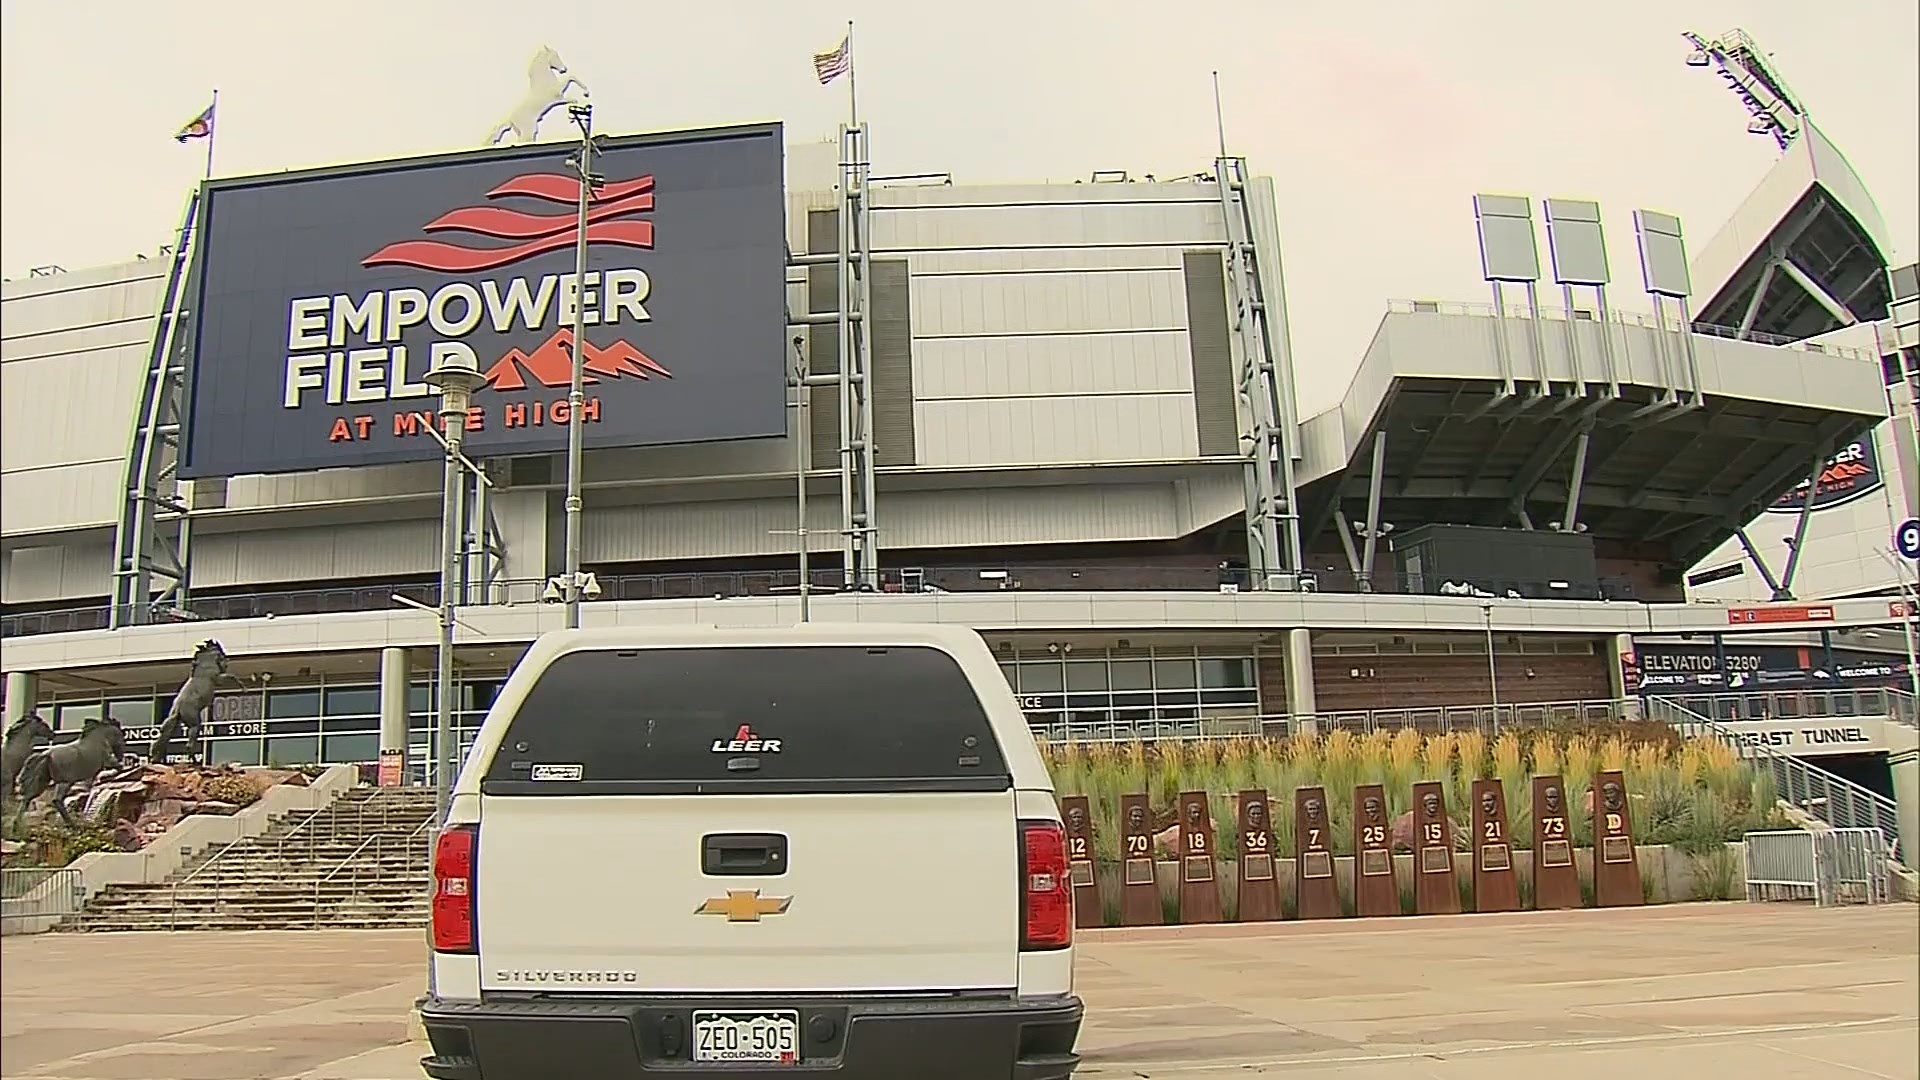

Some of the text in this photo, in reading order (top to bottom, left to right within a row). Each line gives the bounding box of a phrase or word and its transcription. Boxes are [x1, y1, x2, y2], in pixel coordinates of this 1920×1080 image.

[287, 268, 651, 350] EMPOWER
[329, 414, 373, 442] AT
[505, 398, 602, 427] HIGH
[1903, 528, 1919, 552] 9
[213, 695, 261, 721] OPEN
[1020, 696, 1043, 708] ICE
[181, 726, 214, 738] TM
[228, 722, 268, 735] STORE
[1801, 728, 1870, 744] TUNNEL
[711, 739, 782, 752] LEER
[1424, 823, 1442, 841] 15
[1484, 821, 1501, 838] 21
[1541, 817, 1565, 834] 73
[1187, 832, 1205, 849] 18
[1245, 831, 1267, 848] 36
[1309, 829, 1320, 845] 7
[1363, 826, 1385, 843] 25
[1070, 837, 1086, 854] 12
[1127, 835, 1148, 852] 70
[496, 968, 638, 983] SILVERADO
[720, 1051, 772, 1059] COLORADO
